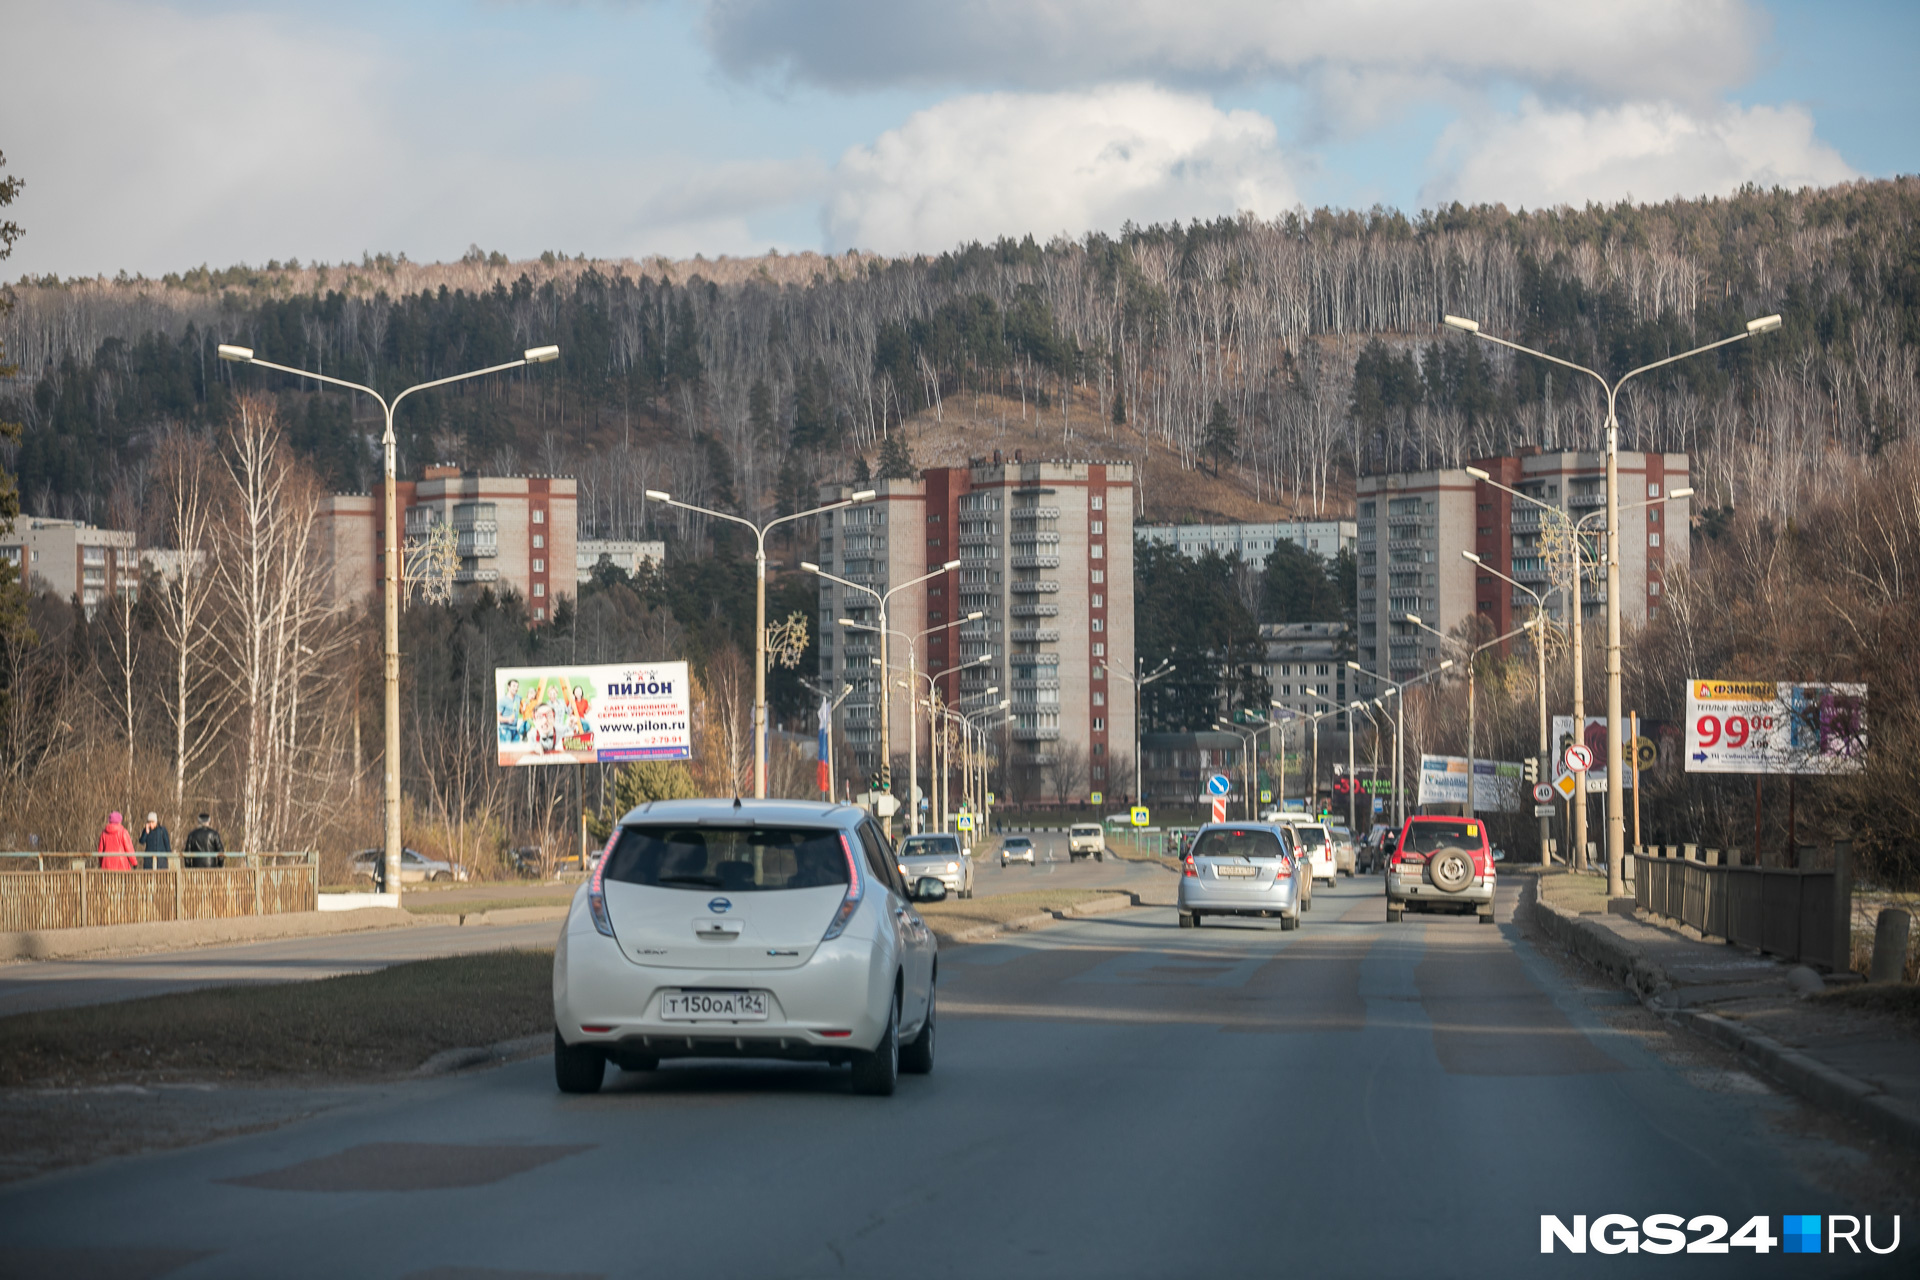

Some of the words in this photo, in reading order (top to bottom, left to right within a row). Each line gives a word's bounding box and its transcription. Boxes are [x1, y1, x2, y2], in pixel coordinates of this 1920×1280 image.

[608, 682, 672, 696] ПИЛОН
[604, 704, 624, 712] САЙТ
[627, 703, 678, 711] ОБНОВИЛСЯ!
[597, 711, 628, 719] СЕРВИС
[631, 710, 685, 718] УПРОСТИЛСЯ!
[600, 720, 685, 734] www.pilon.ru
[1697, 715, 1750, 749] 99
[651, 736, 682, 745] 2-79-91
[1538, 788, 1550, 798] 40
[738, 995, 762, 1010] 124
